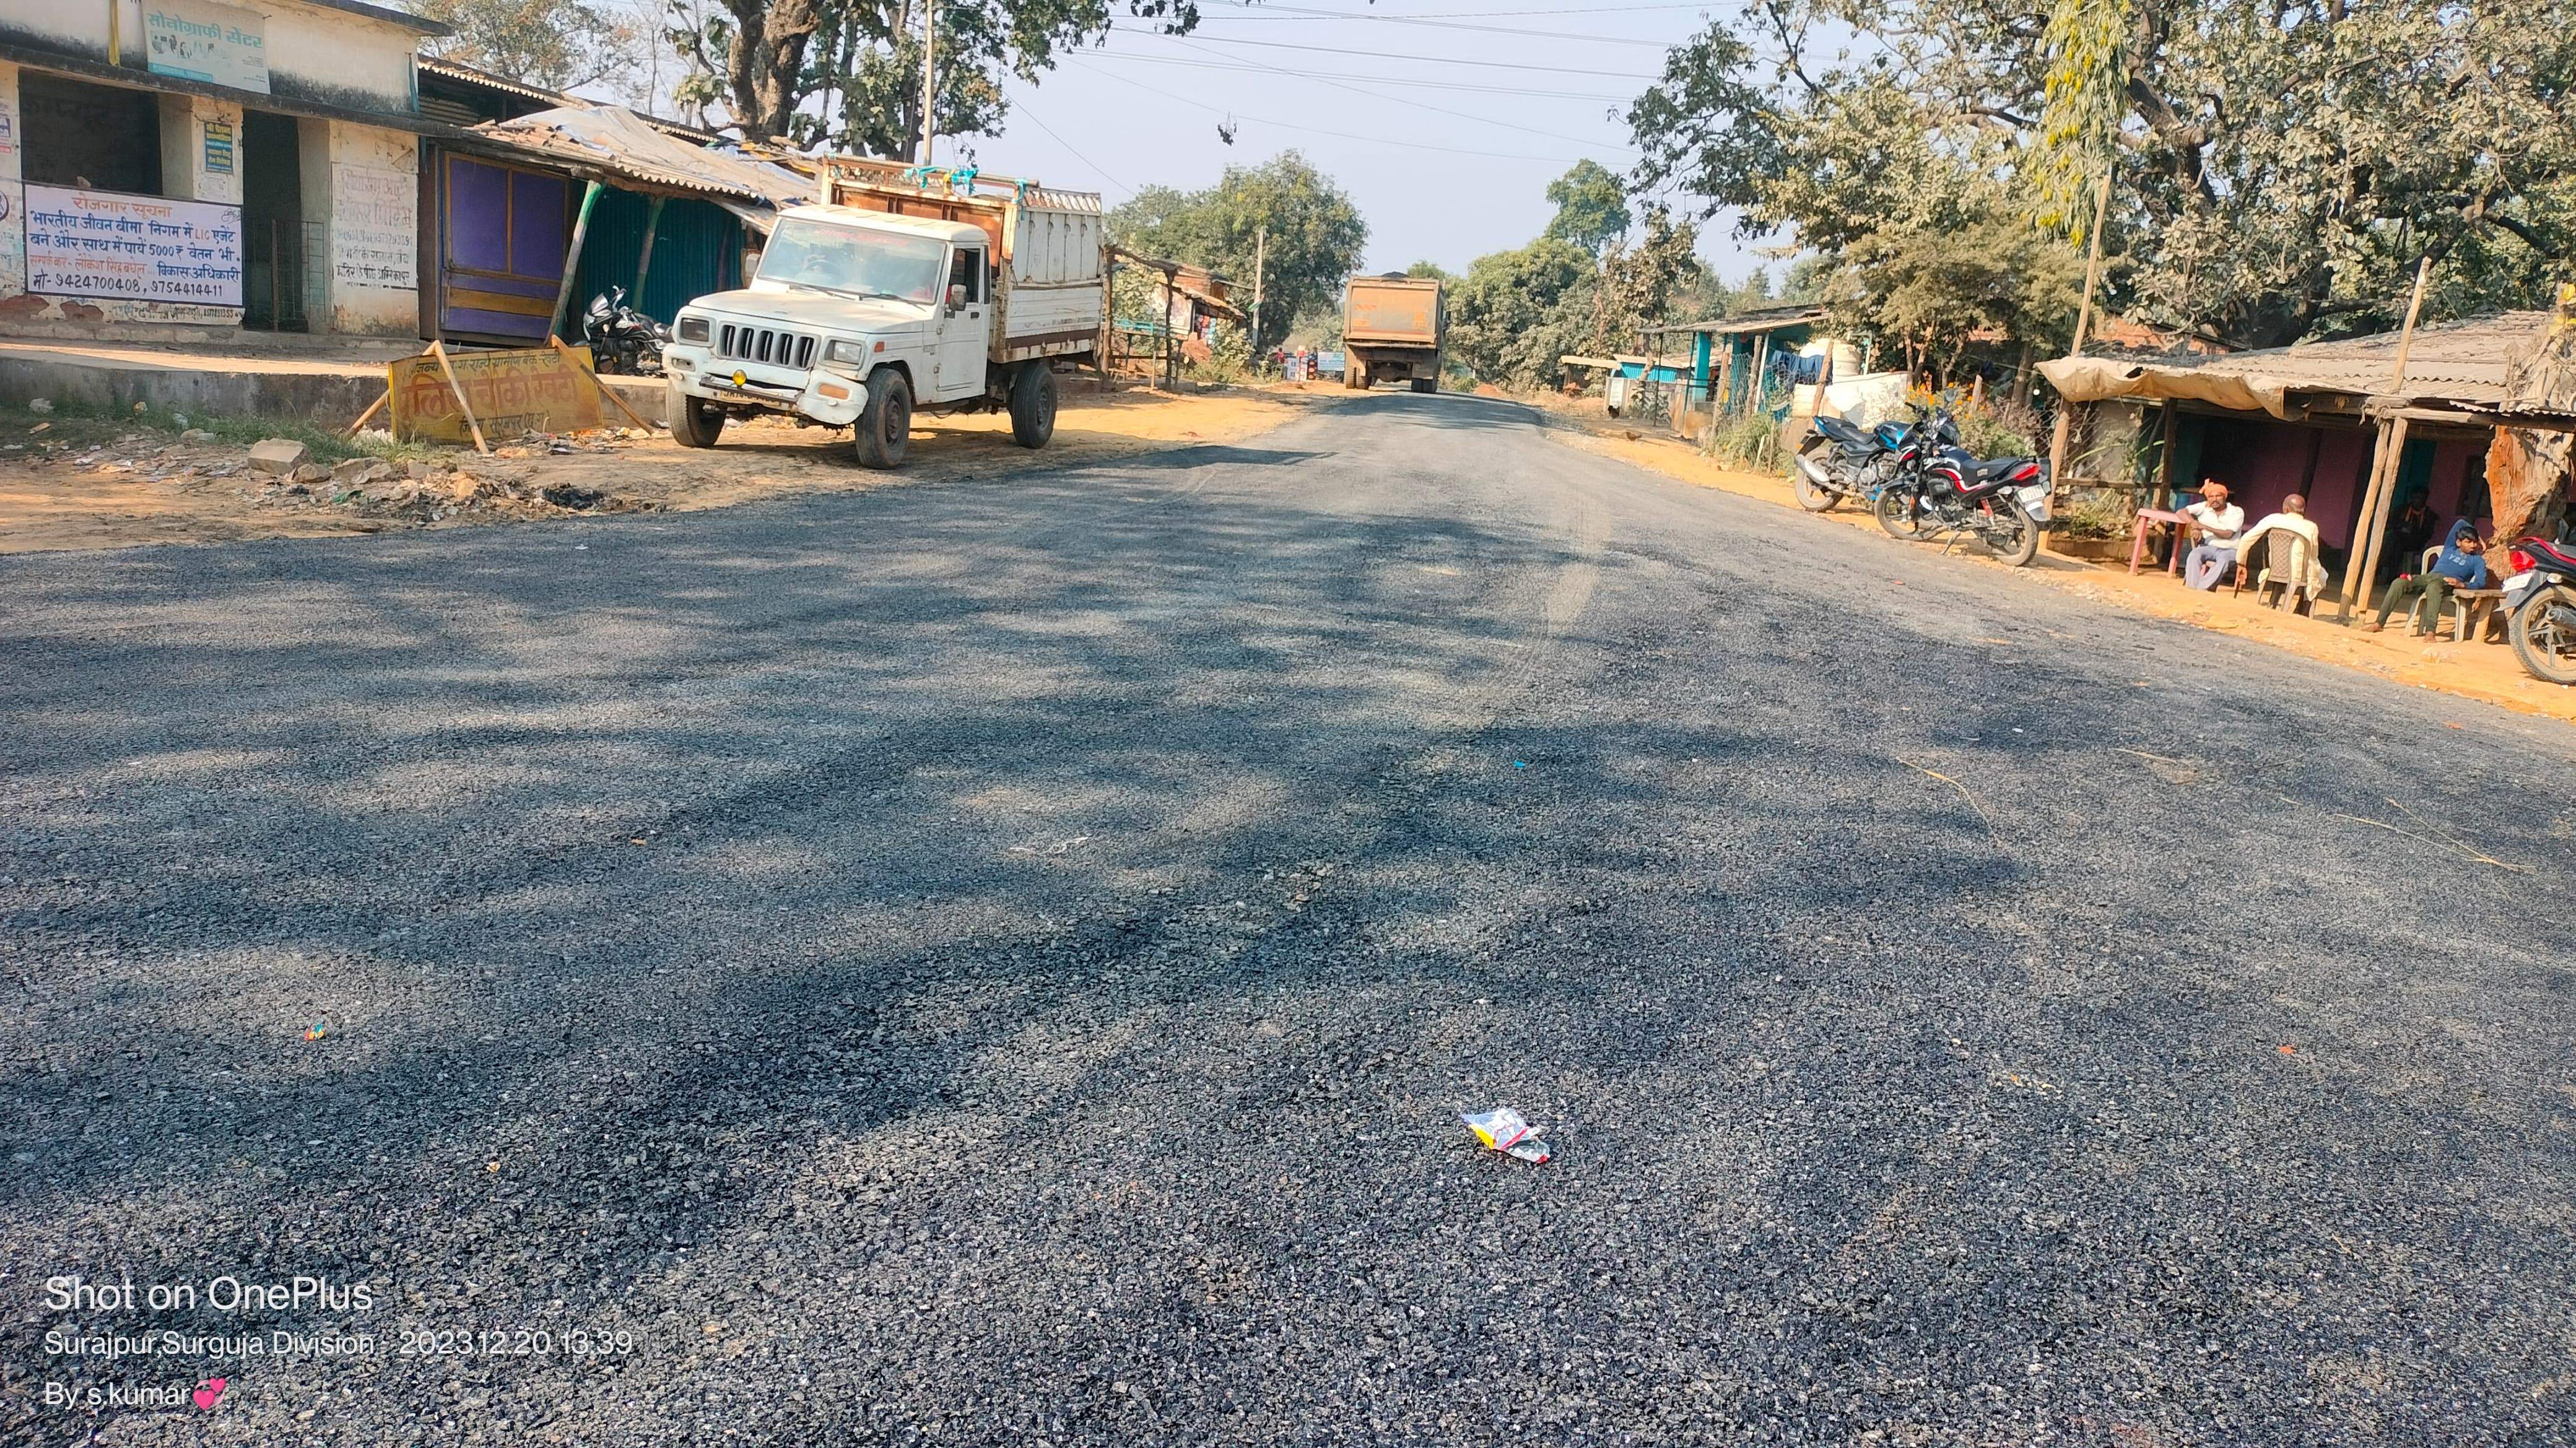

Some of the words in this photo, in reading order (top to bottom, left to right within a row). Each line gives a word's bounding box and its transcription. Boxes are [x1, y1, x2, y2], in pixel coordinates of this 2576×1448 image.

[147, 10, 222, 40] सोनोग्राफी
[225, 27, 263, 49] सेंटर
[71, 193, 129, 214] रोजगार
[131, 203, 172, 220] सूचना
[30, 210, 79, 228] भारतीय
[80, 213, 113, 231] जीवन
[148, 220, 181, 238] निगम
[183, 222, 194, 239] में
[212, 225, 236, 244] एजेंट
[29, 228, 51, 246] बने
[53, 230, 80, 251] और
[81, 238, 111, 252] साथ
[112, 235, 123, 253] में
[124, 237, 146, 255] पायें
[188, 242, 214, 260] वेतन
[106, 256, 123, 276] सिंह
[157, 261, 191, 279] विकास
[190, 263, 240, 283] अधिकारी
[150, 280, 222, 297] 9754414411
